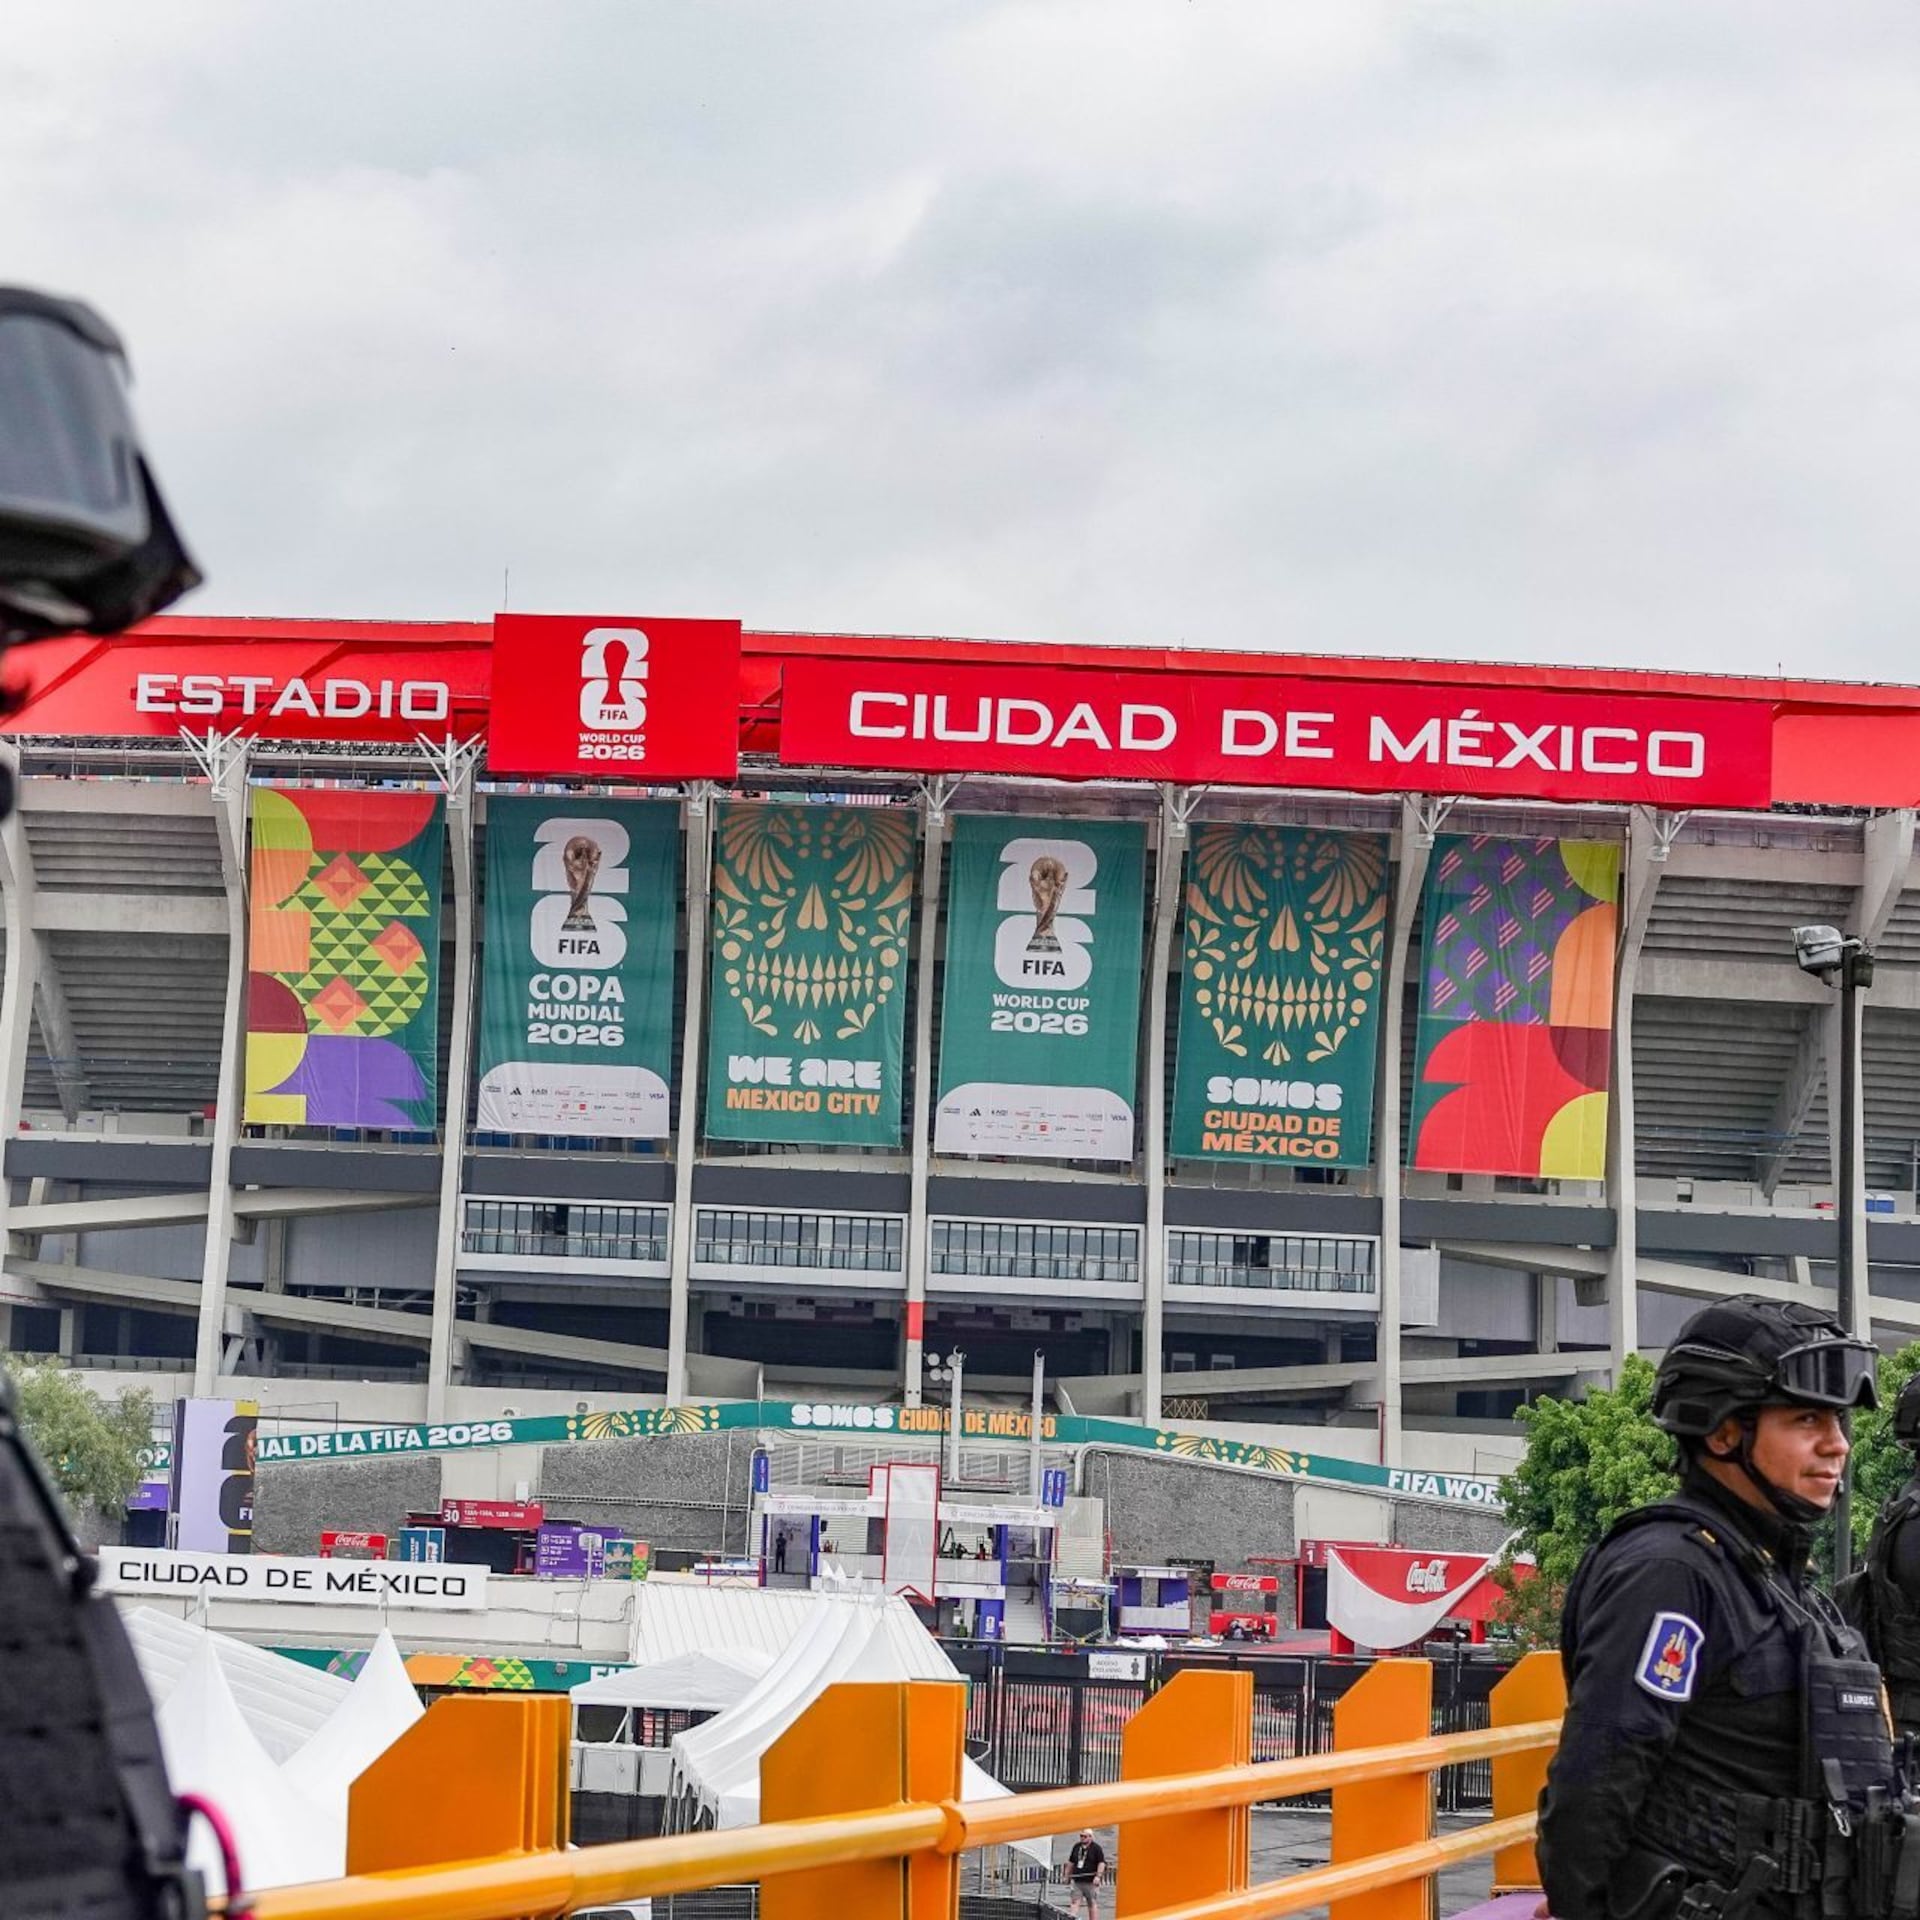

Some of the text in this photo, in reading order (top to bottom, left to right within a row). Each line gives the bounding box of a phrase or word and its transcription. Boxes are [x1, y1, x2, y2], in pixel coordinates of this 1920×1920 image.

[136, 673, 449, 720] ESTADIO
[599, 709, 629, 721] FIFA
[578, 733, 646, 744] WORLD CUP
[849, 691, 1705, 779] CIUDAD DE MÉXICO
[577, 744, 646, 760] 2026
[558, 938, 600, 955] FIFA
[1022, 959, 1065, 976] FIFA
[528, 972, 625, 1003] COPA
[527, 1002, 625, 1022] MUNDIAL
[992, 994, 1090, 1011] WORLD CUP
[527, 1022, 625, 1047] 2026
[991, 1010, 1089, 1036] 2026
[728, 1055, 882, 1090] WE ARE
[726, 1087, 881, 1115] MEXICO CITY
[1206, 1076, 1344, 1111] SOMOS
[1203, 1109, 1342, 1137] CIUDAD DE
[1202, 1130, 1339, 1160] MÉXICO
[791, 1404, 1056, 1438] SOMOS CIUDA DE MÉXIO
[300, 1434, 331, 1455] DE
[335, 1432, 367, 1452] LA
[370, 1428, 423, 1450] FIFA
[428, 1421, 513, 1446] 2026
[1388, 1469, 1507, 1505] FIFA WOR
[443, 1509, 460, 1523] 30
[119, 1561, 466, 1596] CIUDAD DE MÉXICO
